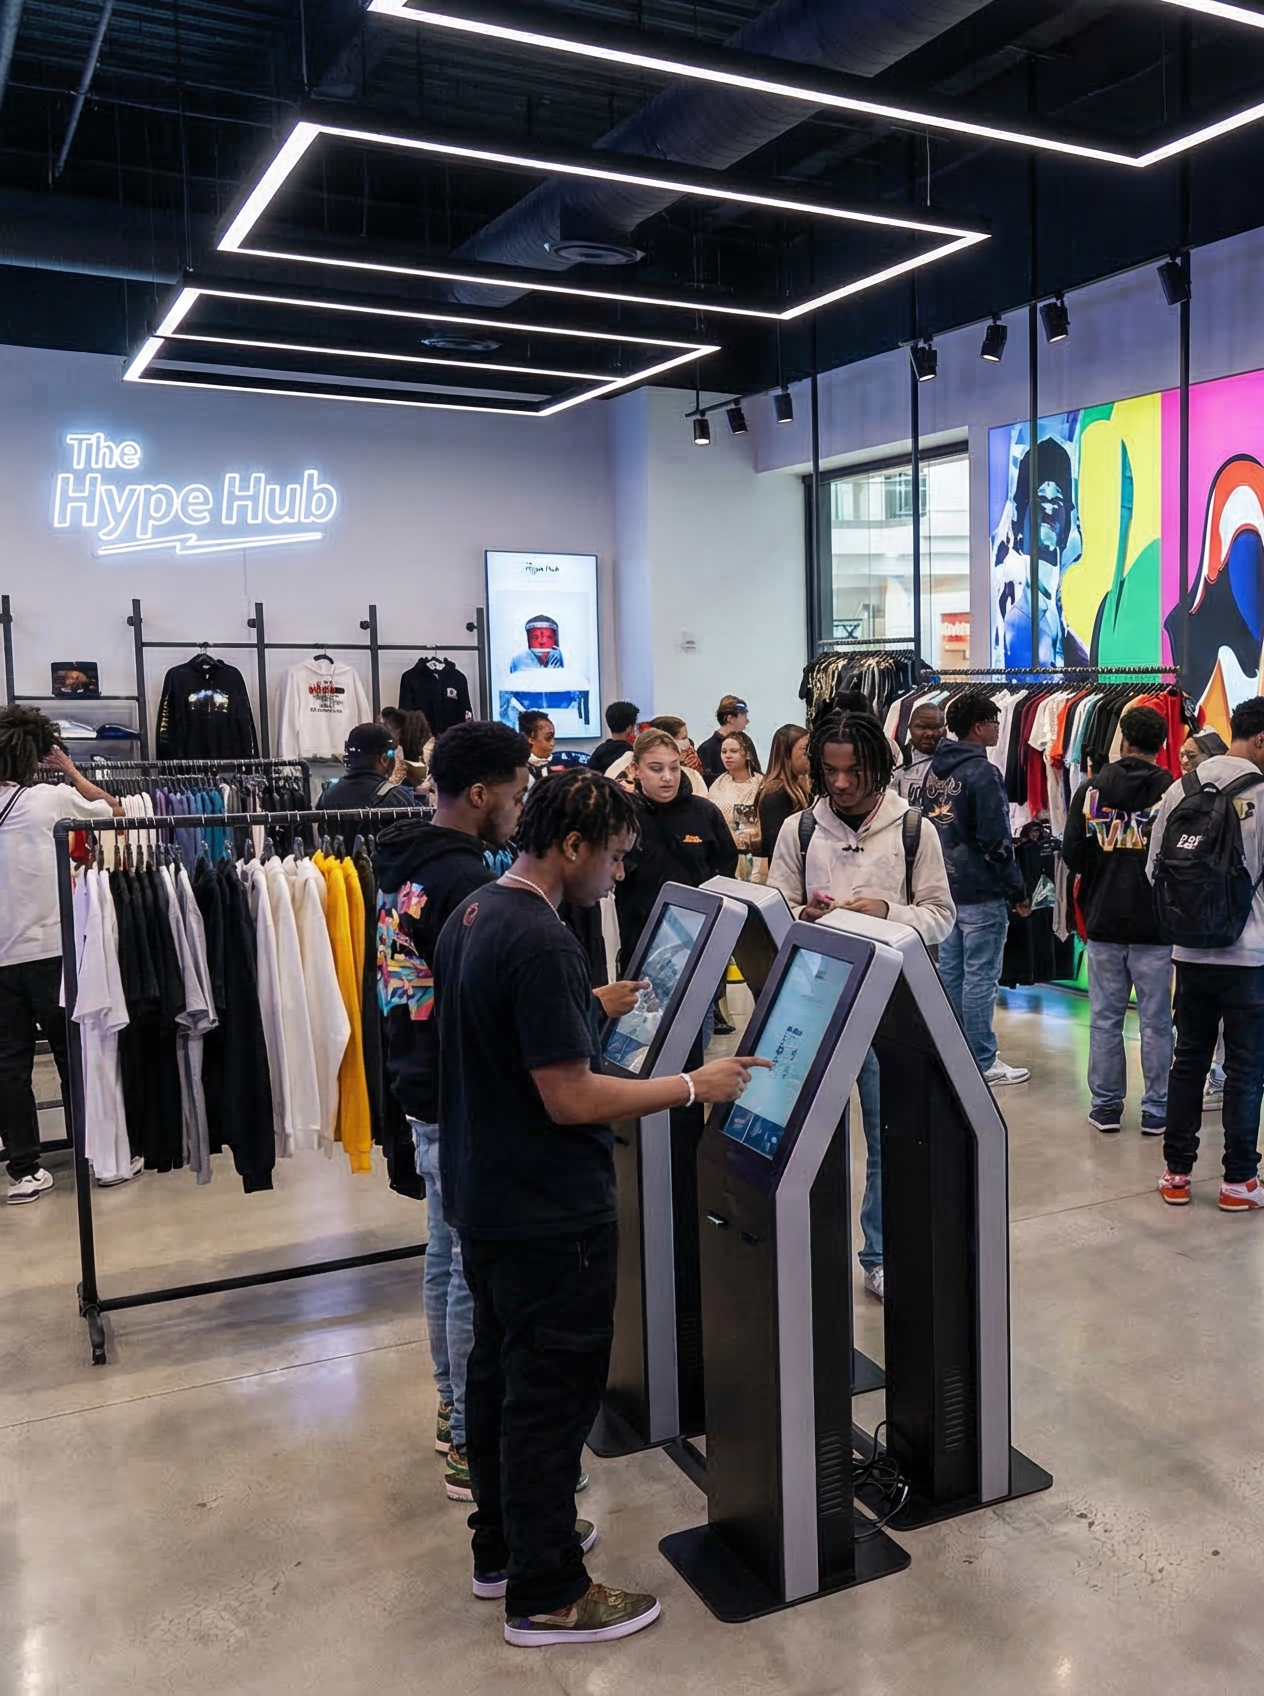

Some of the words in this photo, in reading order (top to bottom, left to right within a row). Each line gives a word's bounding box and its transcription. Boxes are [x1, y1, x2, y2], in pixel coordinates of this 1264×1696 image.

[67, 432, 140, 469] The
[54, 472, 213, 538] Hype
[222, 469, 337, 524] Hub
